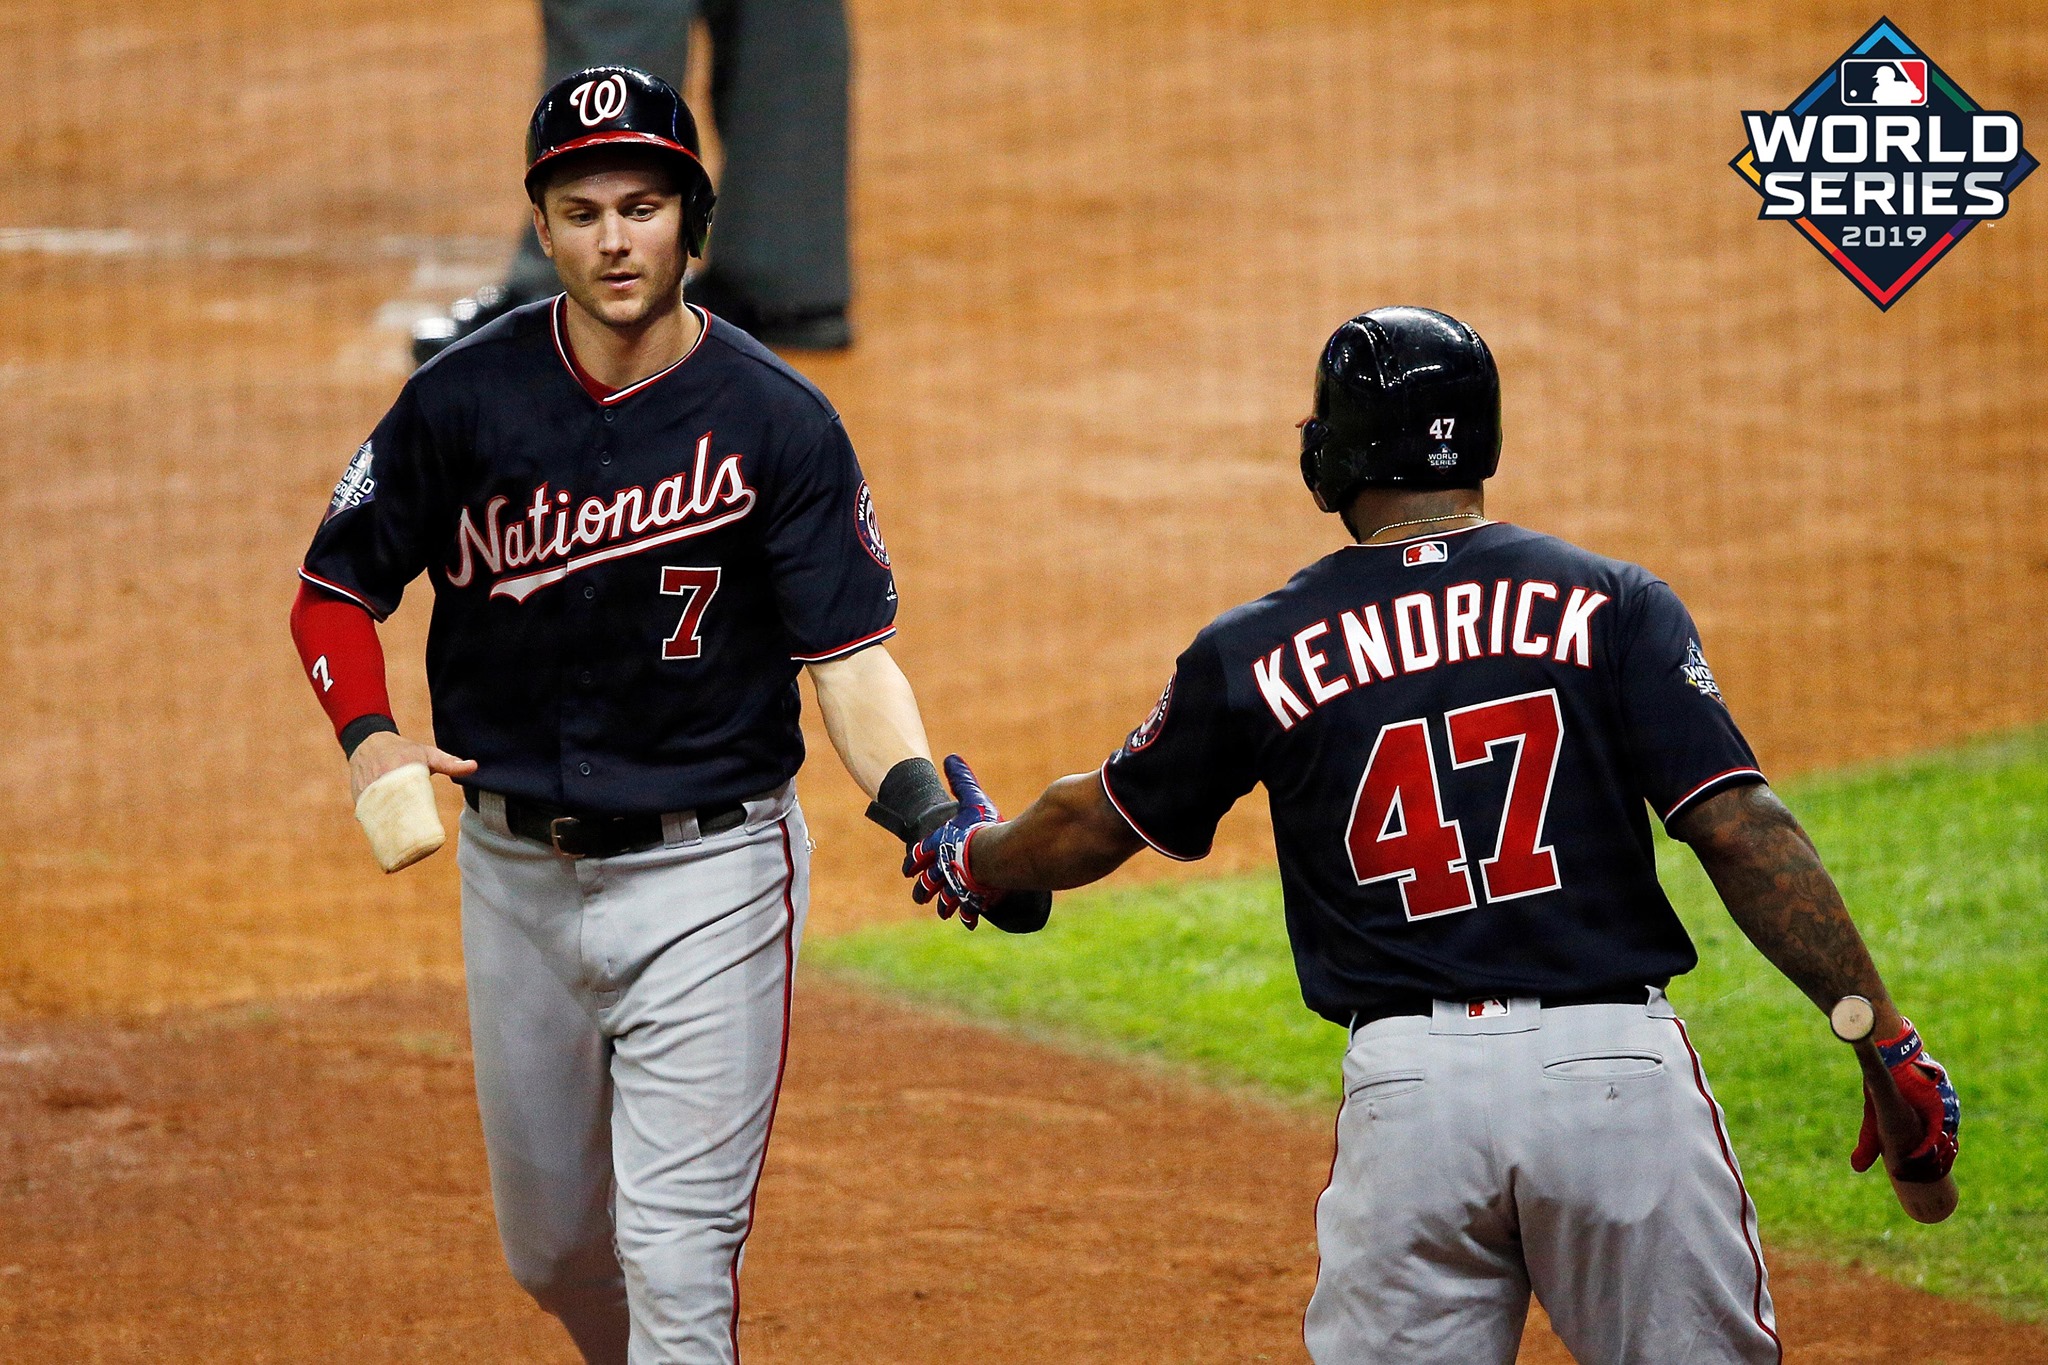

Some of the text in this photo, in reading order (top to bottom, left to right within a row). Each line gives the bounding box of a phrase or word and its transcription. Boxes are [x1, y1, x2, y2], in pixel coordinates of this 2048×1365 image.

[569, 73, 628, 129] W
[1429, 417, 1455, 440] 47
[1428, 452, 1459, 460] WORLD
[342, 465, 376, 495] ORLD
[446, 431, 757, 588] Nationals
[659, 565, 721, 660] 7
[312, 655, 334, 692] 7
[1251, 578, 1610, 731] KENDRICK
[1344, 688, 1564, 922] 47
[1900, 1044, 1911, 1056] 47
